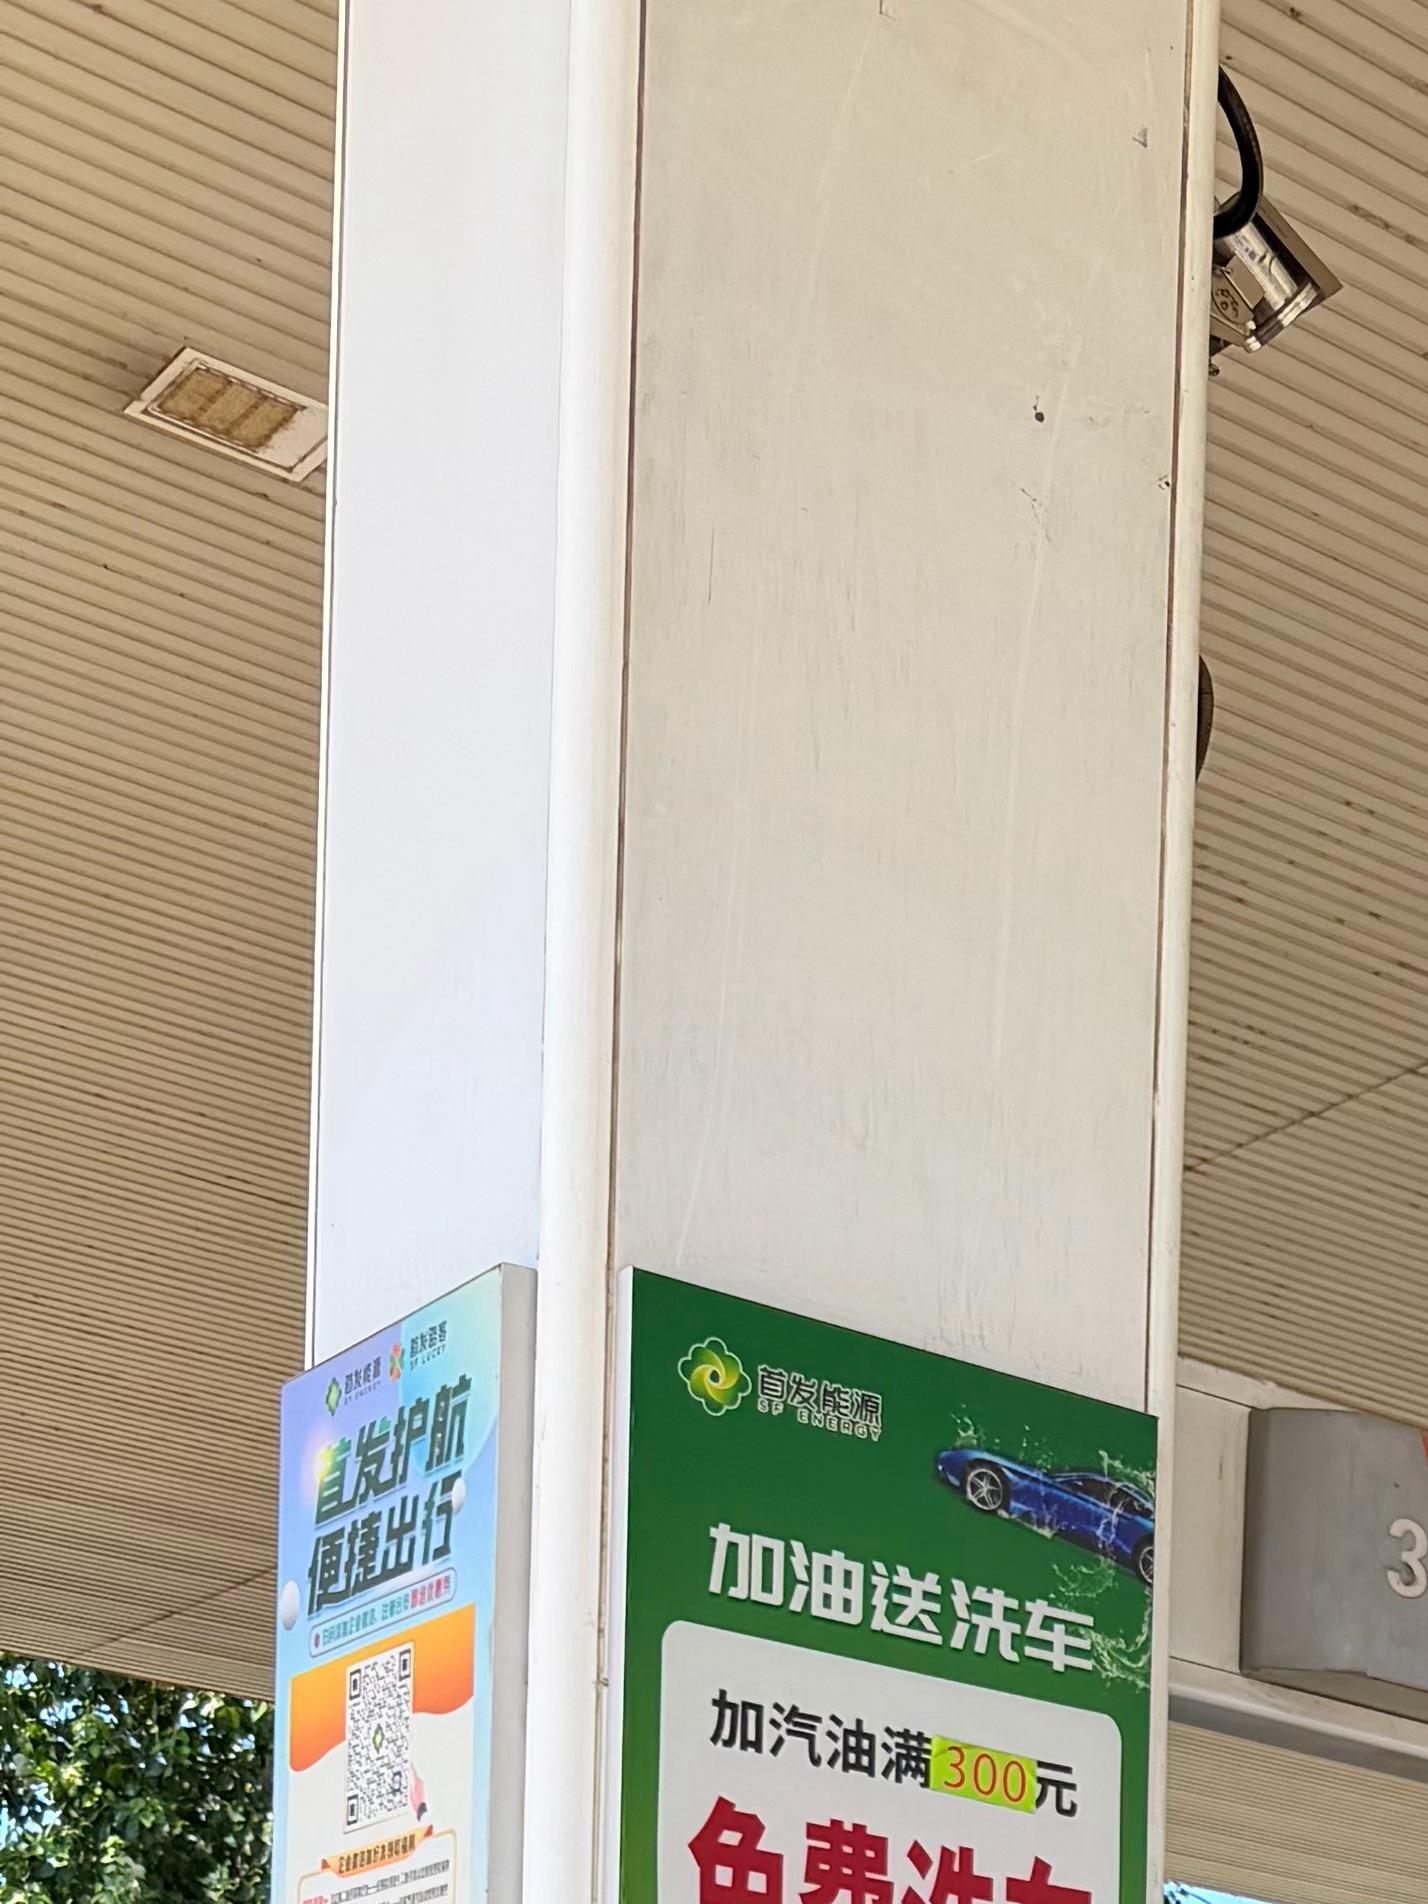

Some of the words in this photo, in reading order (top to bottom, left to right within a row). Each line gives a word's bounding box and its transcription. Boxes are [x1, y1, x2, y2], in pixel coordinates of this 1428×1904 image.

[757, 1366, 883, 1427] 首发能源
[758, 1398, 784, 1417] SF
[798, 1408, 883, 1442] ENERGY
[308, 1470, 464, 1617] 便捷出行
[1386, 1518, 1428, 1599] 3
[708, 1522, 1095, 1673] 加油送洗车
[710, 1689, 1079, 1819] 加汽油满300元
